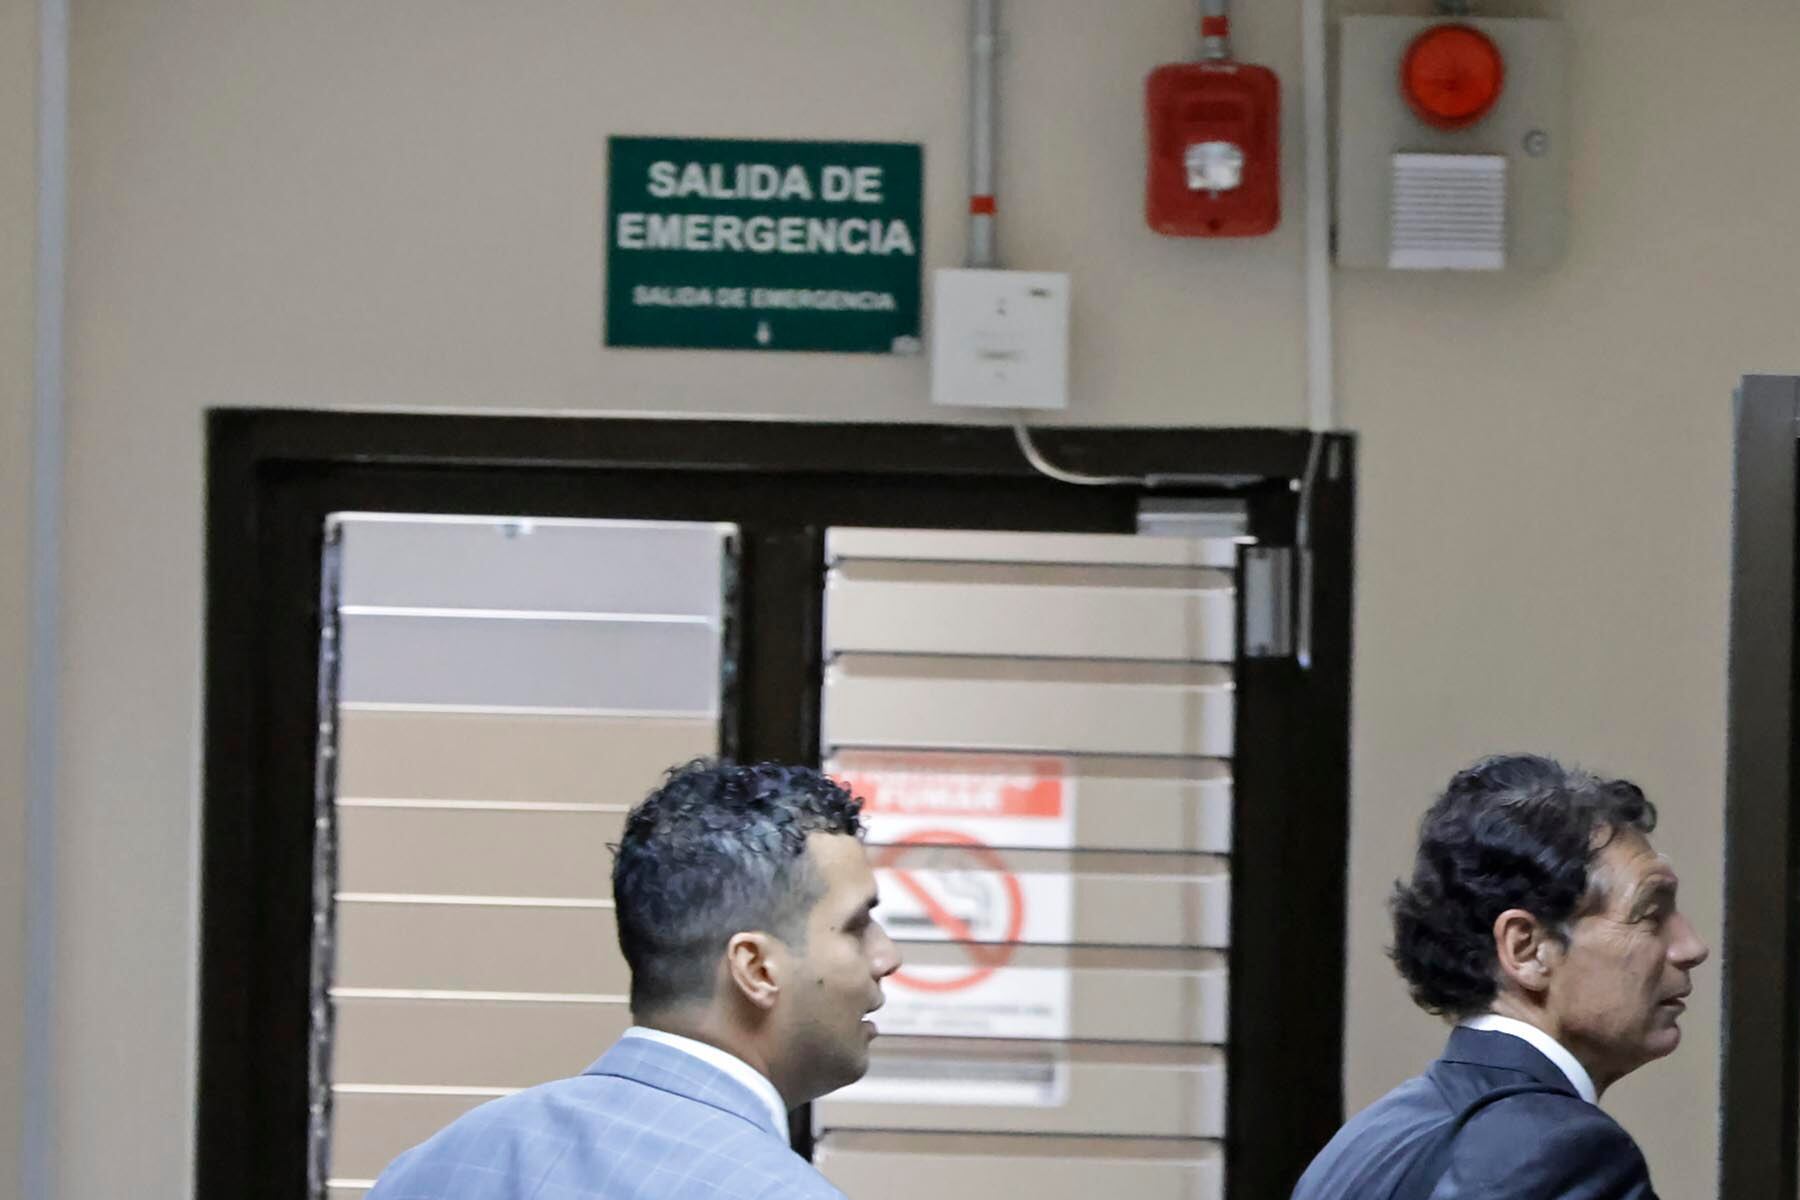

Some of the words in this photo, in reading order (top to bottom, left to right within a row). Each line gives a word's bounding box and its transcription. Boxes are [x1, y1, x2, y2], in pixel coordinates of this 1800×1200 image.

[647, 160, 812, 200] SALIDA
[821, 166, 883, 202] DE
[616, 212, 915, 256] EMERGENCIA
[633, 285, 713, 307] SALIDA
[715, 287, 747, 308] DE
[750, 288, 896, 311] EMERGENCIA
